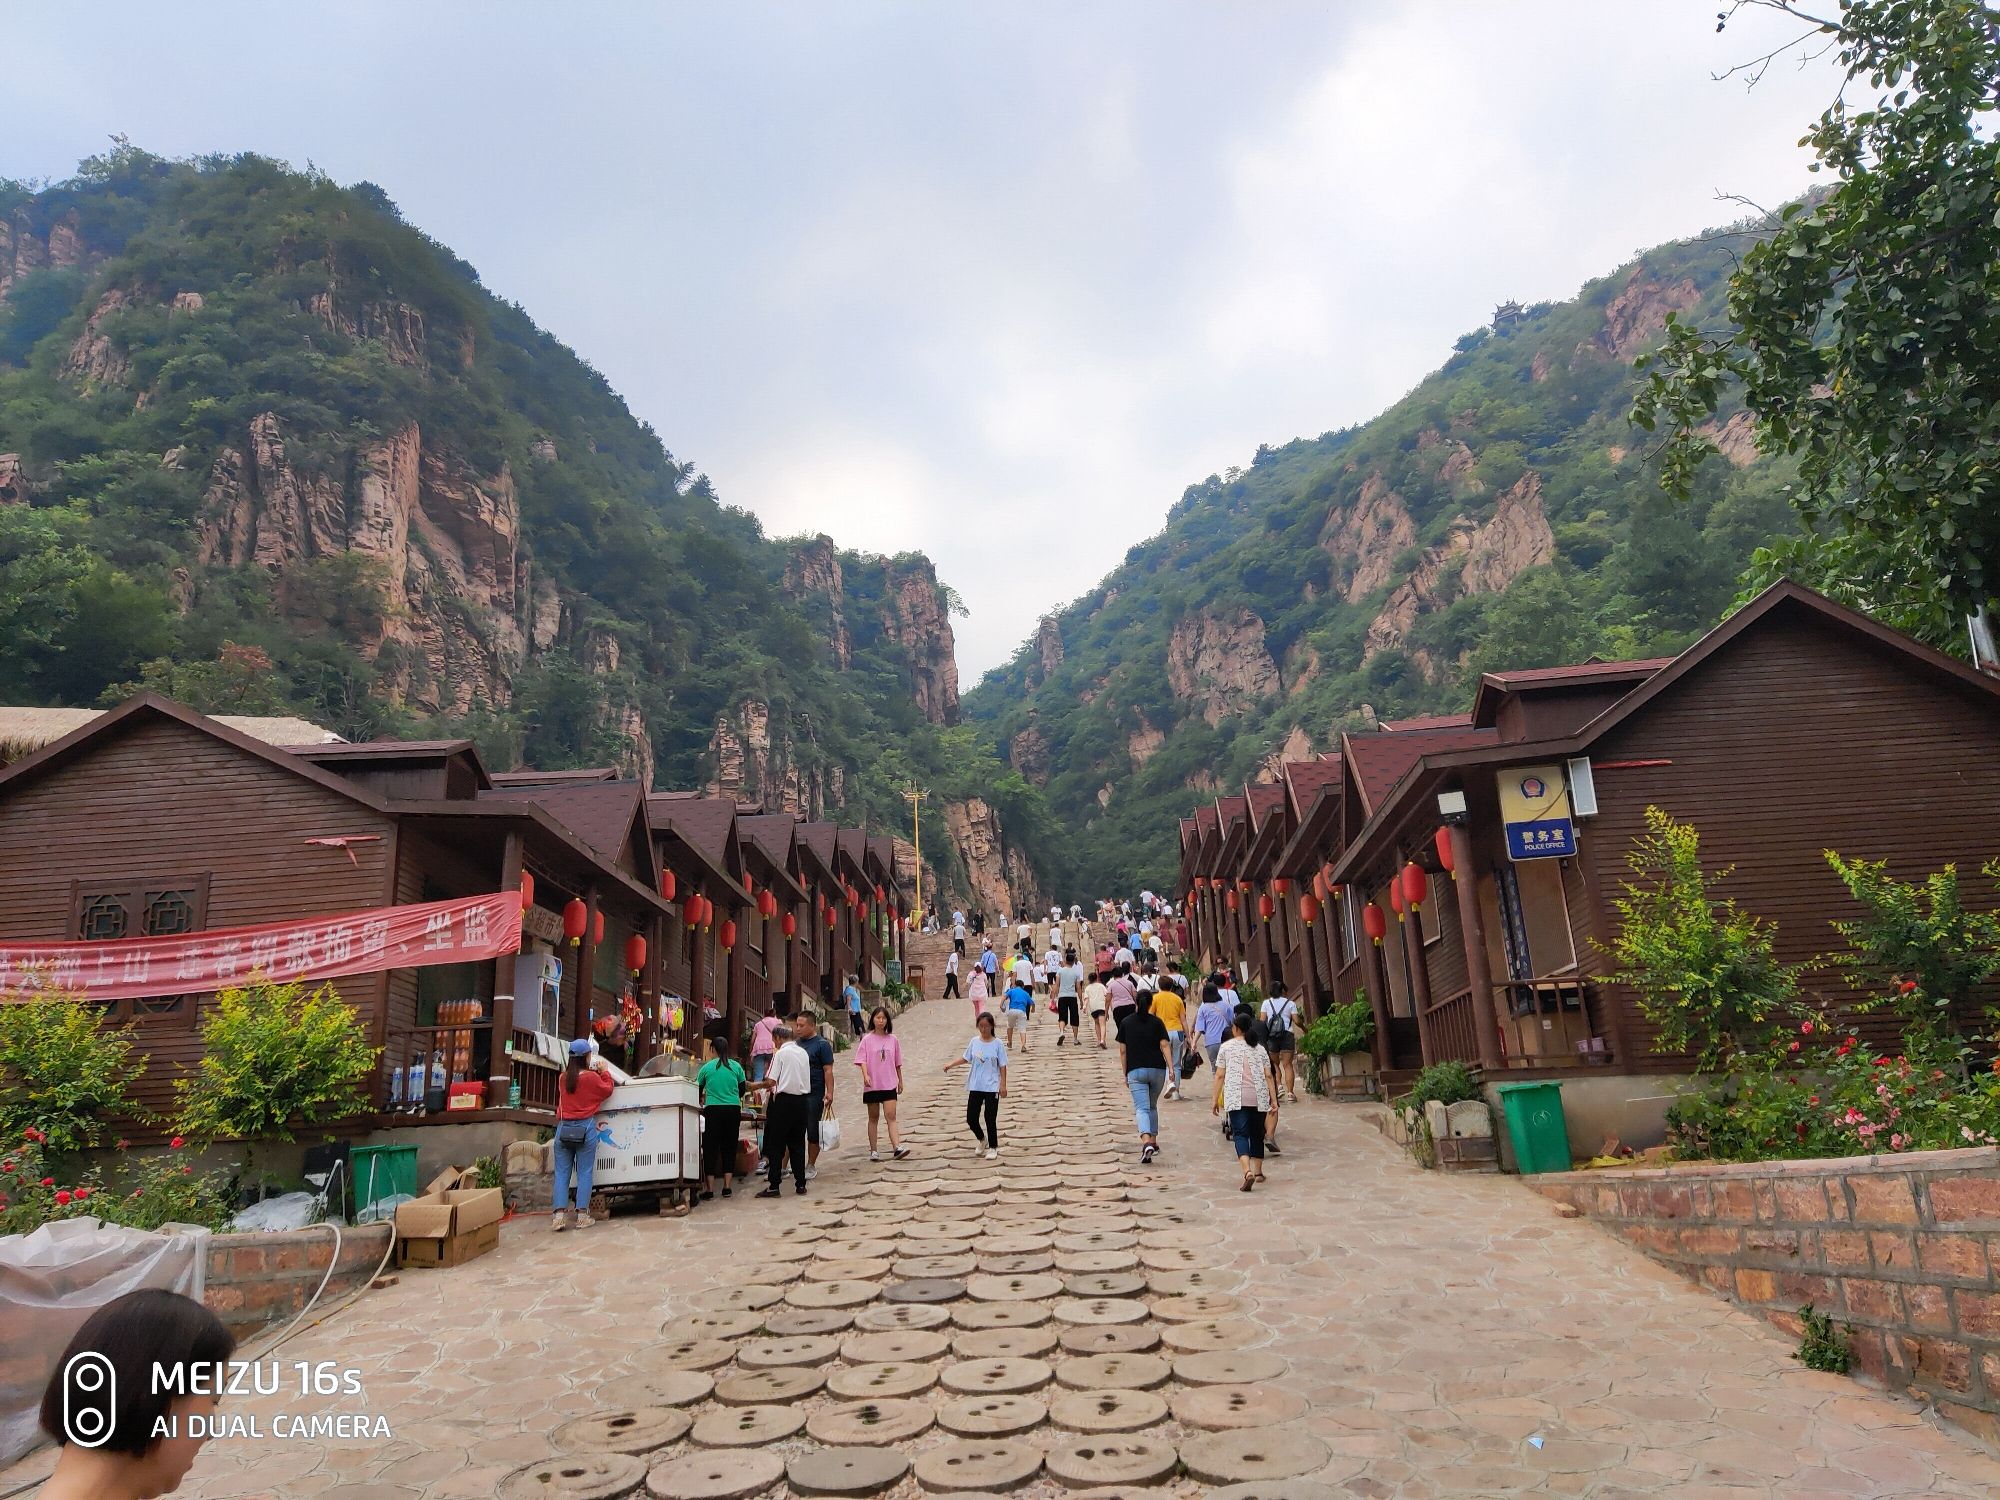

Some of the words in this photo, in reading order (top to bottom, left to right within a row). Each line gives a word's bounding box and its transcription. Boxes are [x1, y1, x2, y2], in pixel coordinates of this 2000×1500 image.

[1522, 829, 1565, 843] 警务室
[1525, 843, 1545, 851] POLICE
[1545, 841, 1566, 849] OFFICE
